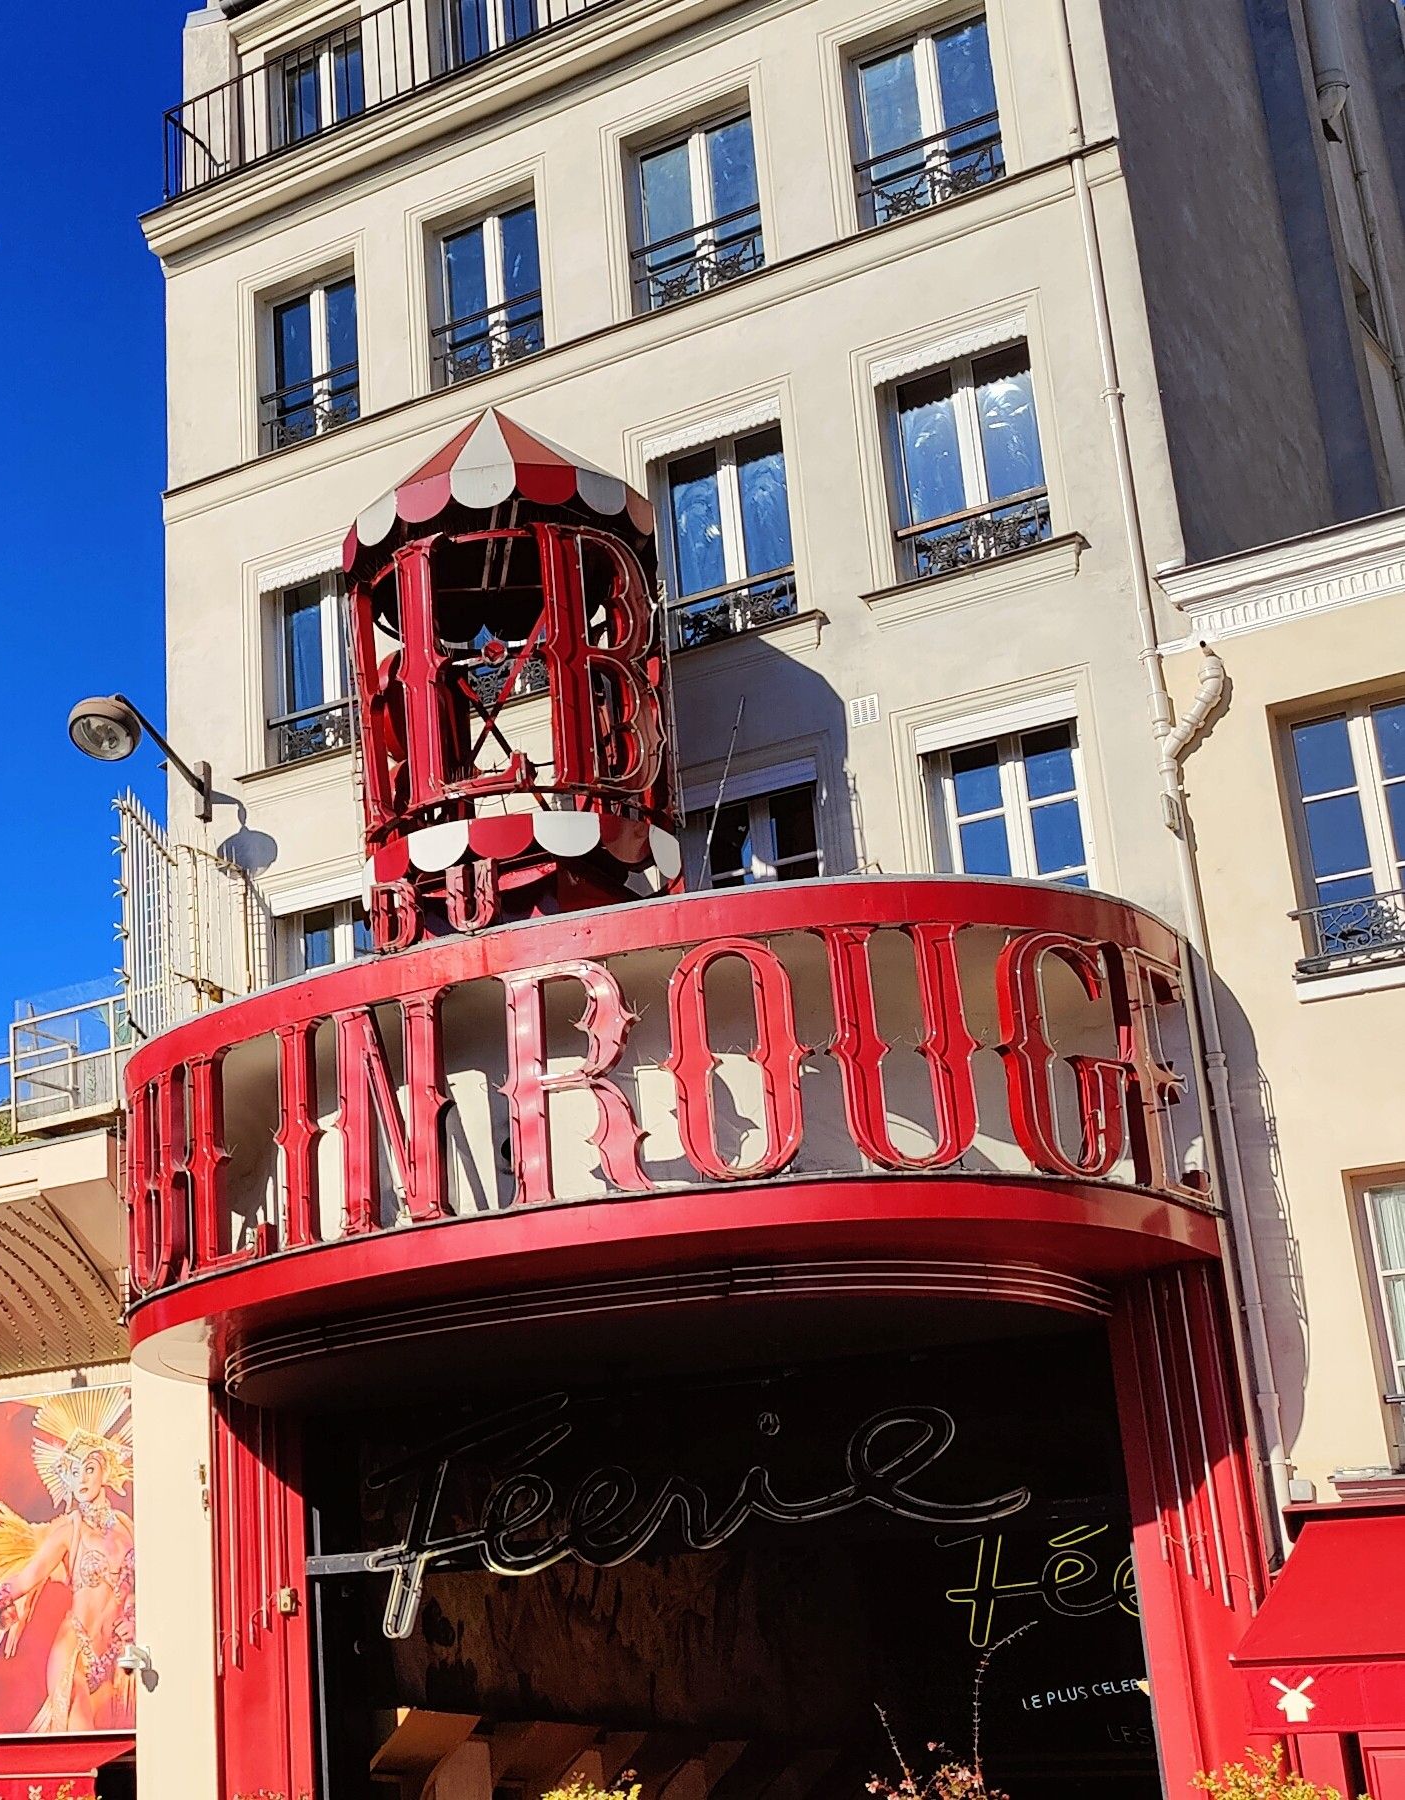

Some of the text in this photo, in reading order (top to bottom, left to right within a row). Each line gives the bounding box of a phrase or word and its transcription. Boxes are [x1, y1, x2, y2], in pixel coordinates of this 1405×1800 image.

[493, 921, 1215, 1207] ROUGE
[1022, 1677, 1148, 1710] LE PLUS CELEB
